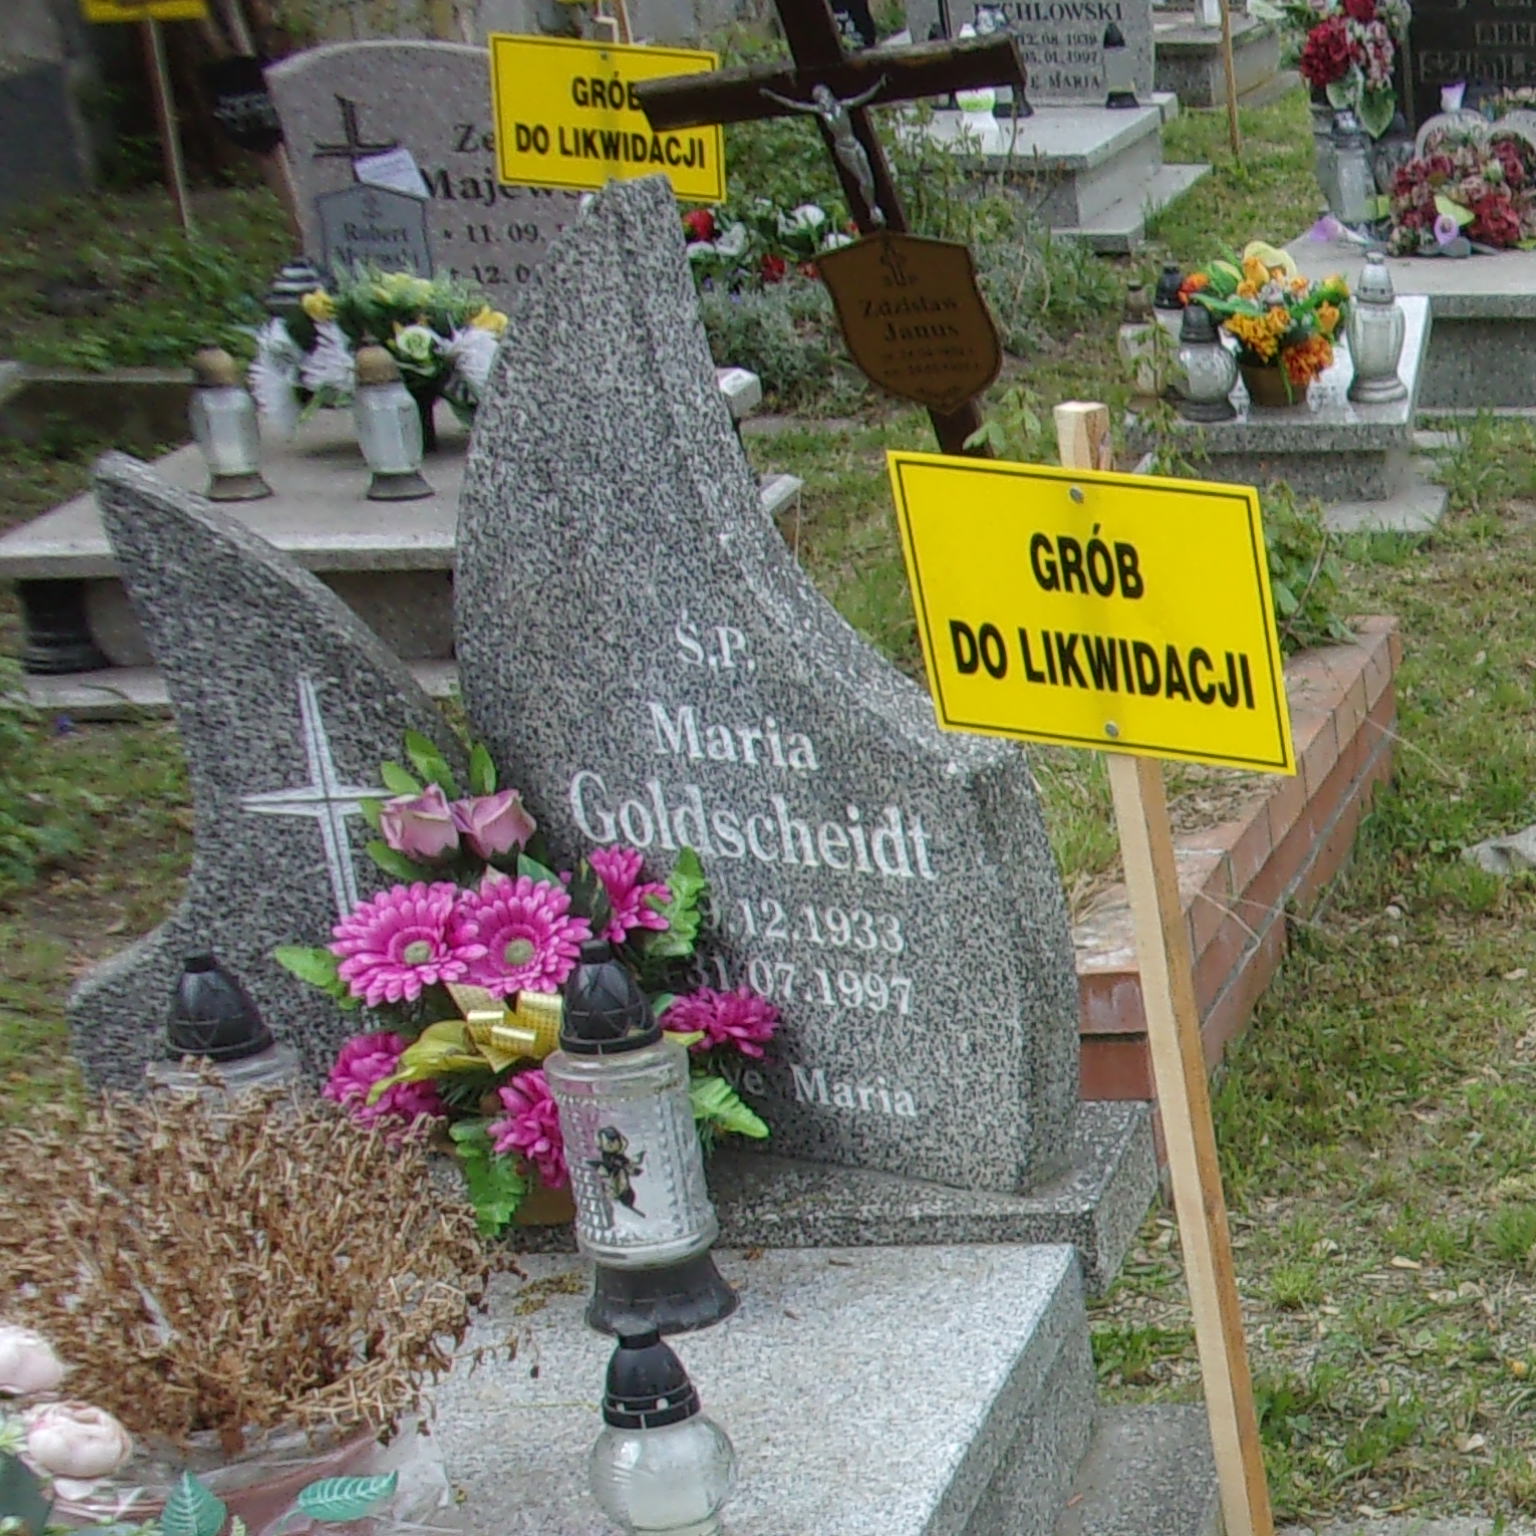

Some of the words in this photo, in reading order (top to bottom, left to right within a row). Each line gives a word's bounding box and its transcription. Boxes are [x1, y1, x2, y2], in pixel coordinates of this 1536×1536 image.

[515, 122, 549, 155] DO
[558, 126, 706, 169] LIKWIDACJI
[1029, 523, 1145, 600] GRÓB
[948, 618, 1008, 681] DO
[1017, 625, 1257, 710] LIKWIDACJI
[649, 701, 821, 772] Maria
[569, 769, 940, 882] Goldscheidt
[788, 1063, 917, 1118] Maria
